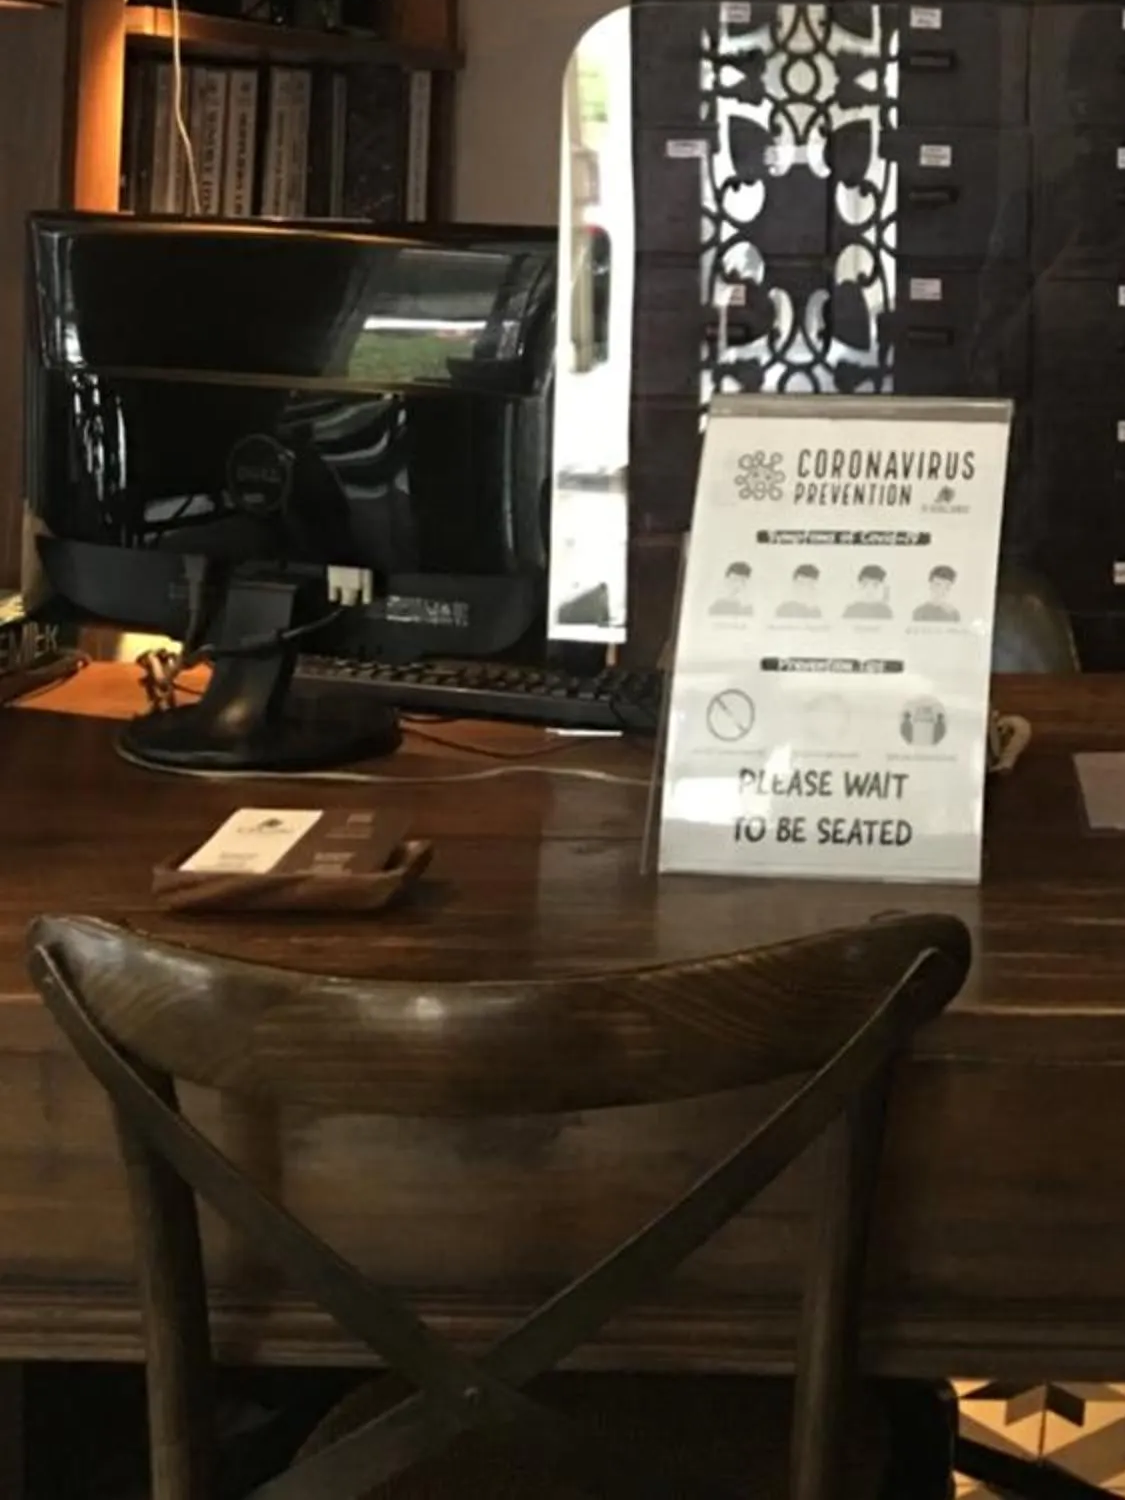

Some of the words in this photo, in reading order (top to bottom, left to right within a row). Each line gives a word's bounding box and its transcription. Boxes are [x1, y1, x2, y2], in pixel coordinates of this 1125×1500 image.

[797, 449, 976, 480] CORONAVIRUS
[793, 482, 913, 506] PREVENTION
[739, 767, 833, 797] PLEASE
[844, 771, 909, 799] WAIT
[734, 816, 766, 843] TO
[776, 817, 807, 843] BE
[817, 818, 913, 846] SEATED
